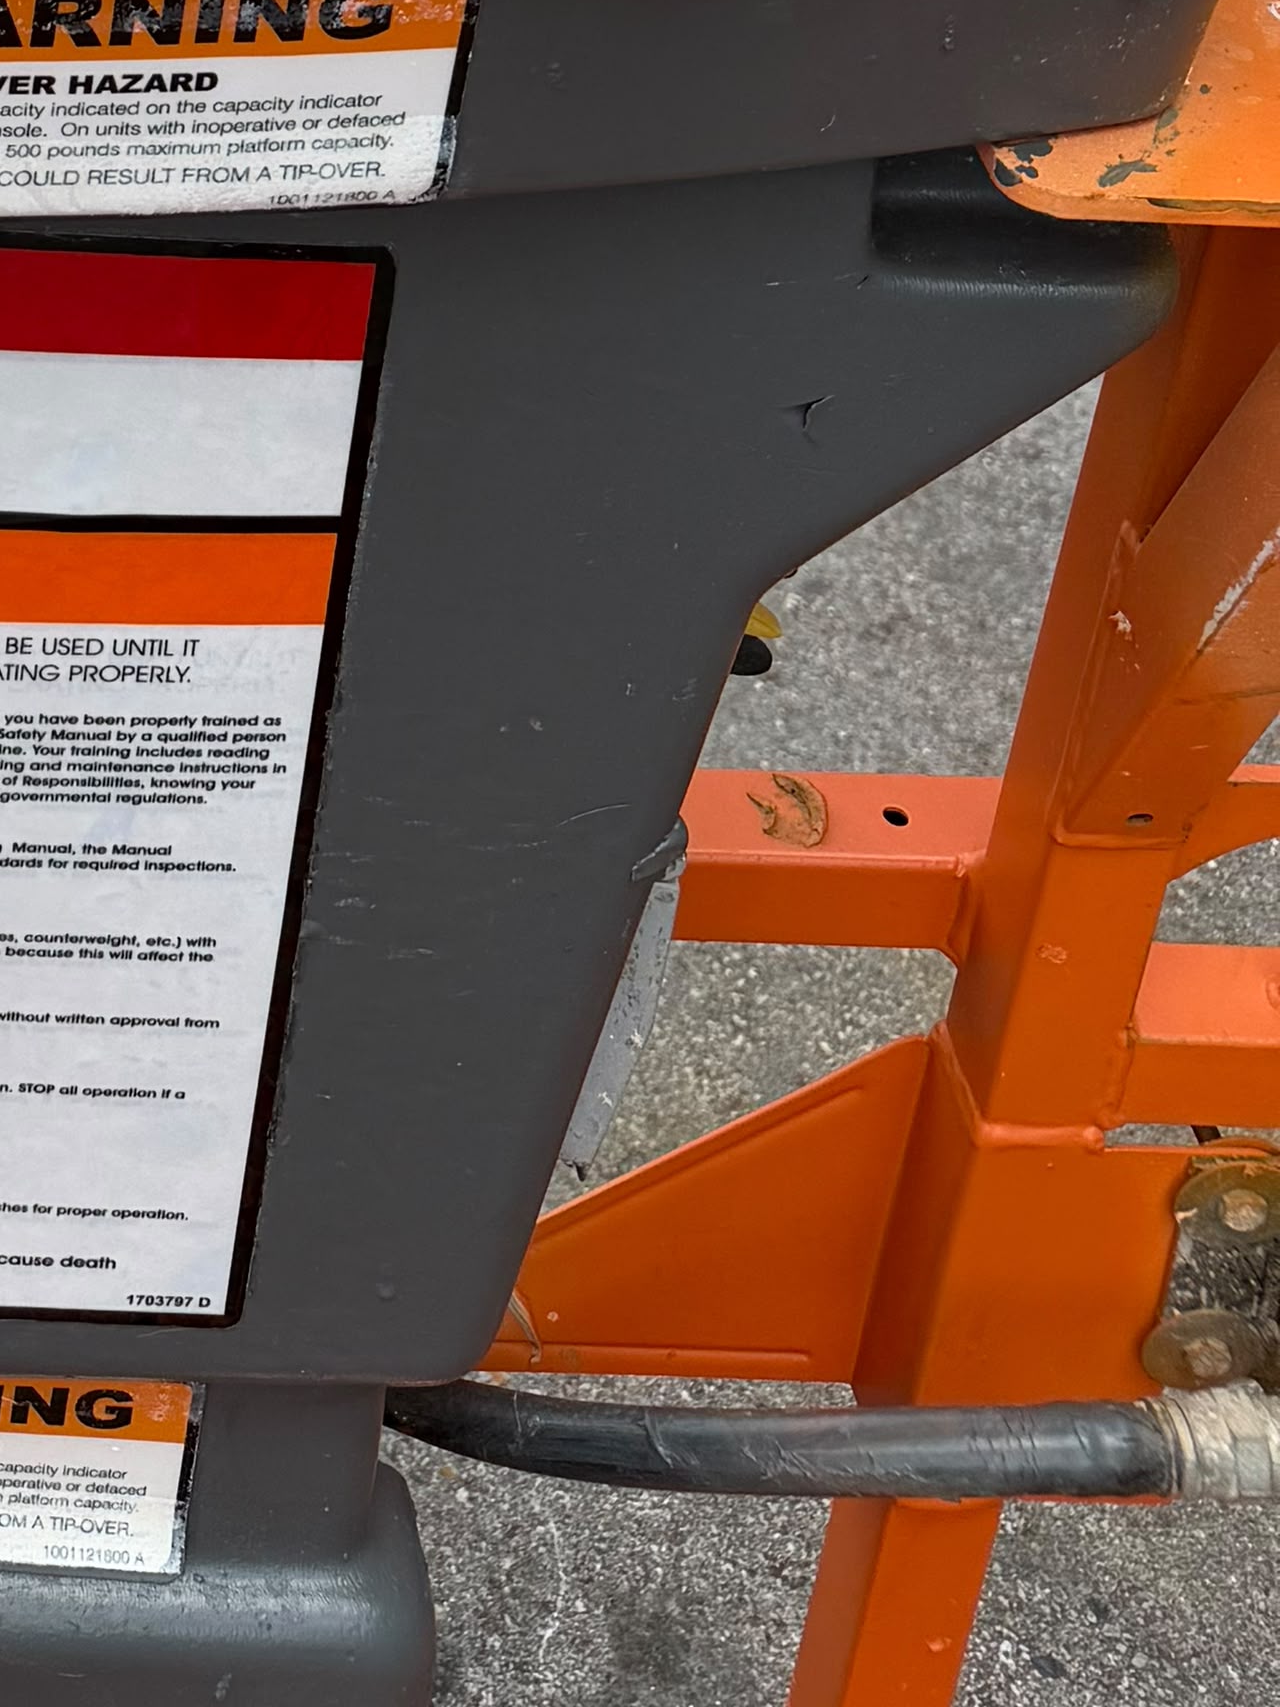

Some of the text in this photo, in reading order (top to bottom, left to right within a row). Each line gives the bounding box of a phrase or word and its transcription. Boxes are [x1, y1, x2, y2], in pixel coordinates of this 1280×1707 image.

[69, 73, 218, 94] HAZARD
[51, 101, 140, 117] indicated
[146, 103, 170, 115] on
[177, 100, 206, 114] the
[213, 97, 294, 116] capacity
[300, 94, 382, 110] indicator
[6, 637, 32, 654] BE
[42, 638, 104, 656] USED
[113, 638, 173, 657] UNTIL
[183, 639, 200, 656] IT
[69, 664, 190, 684] PROPERLY.
[127, 1295, 210, 1307] 1703797 D
